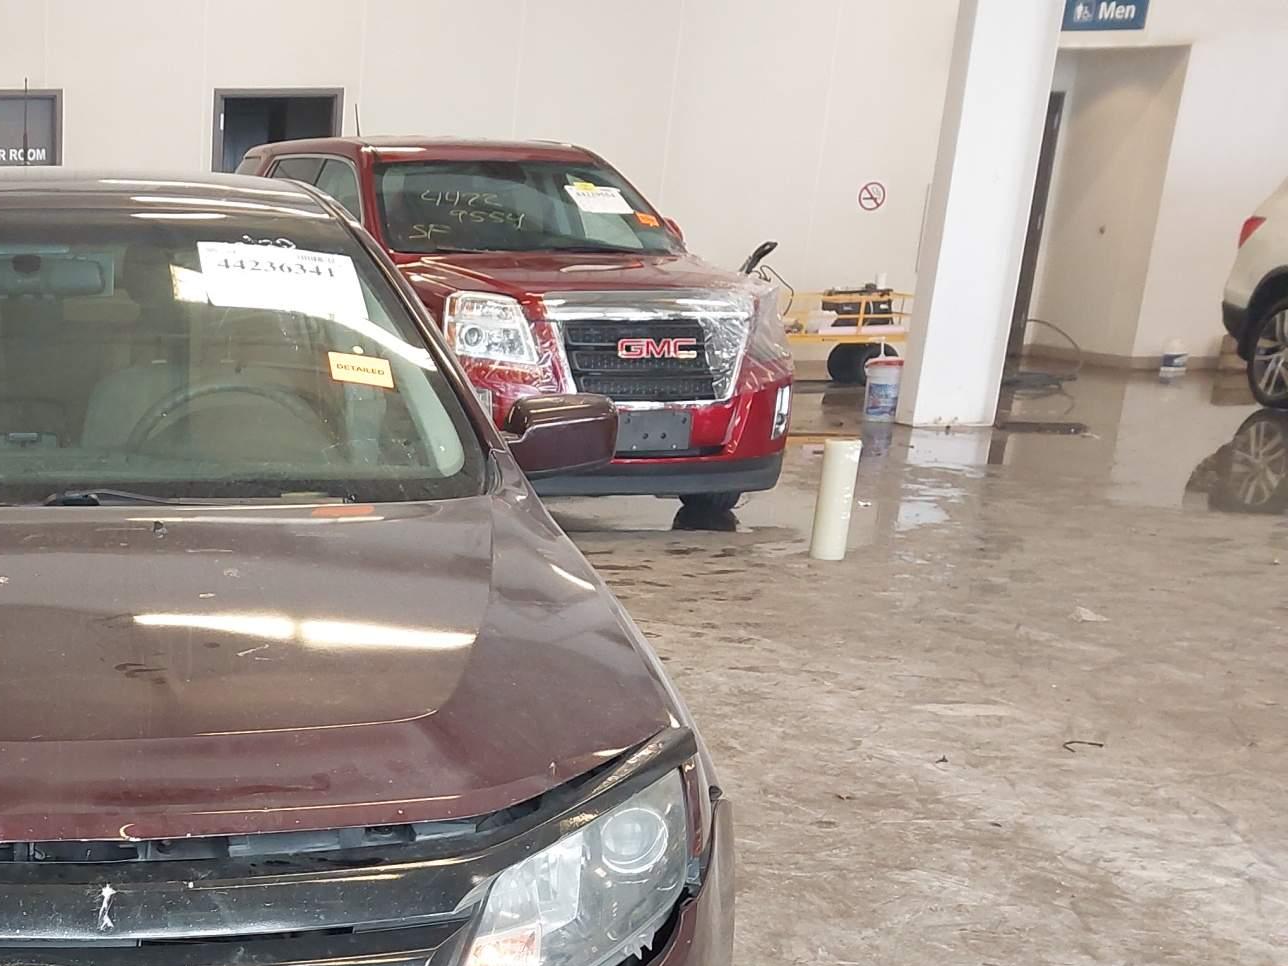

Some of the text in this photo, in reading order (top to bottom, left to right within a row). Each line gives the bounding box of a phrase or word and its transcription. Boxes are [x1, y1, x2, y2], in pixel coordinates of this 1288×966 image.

[1098, 1, 1136, 20] Men
[408, 223, 451, 240] SF
[217, 258, 335, 278] 44236341
[617, 338, 697, 359] GMC
[336, 363, 385, 376] DETAILED
